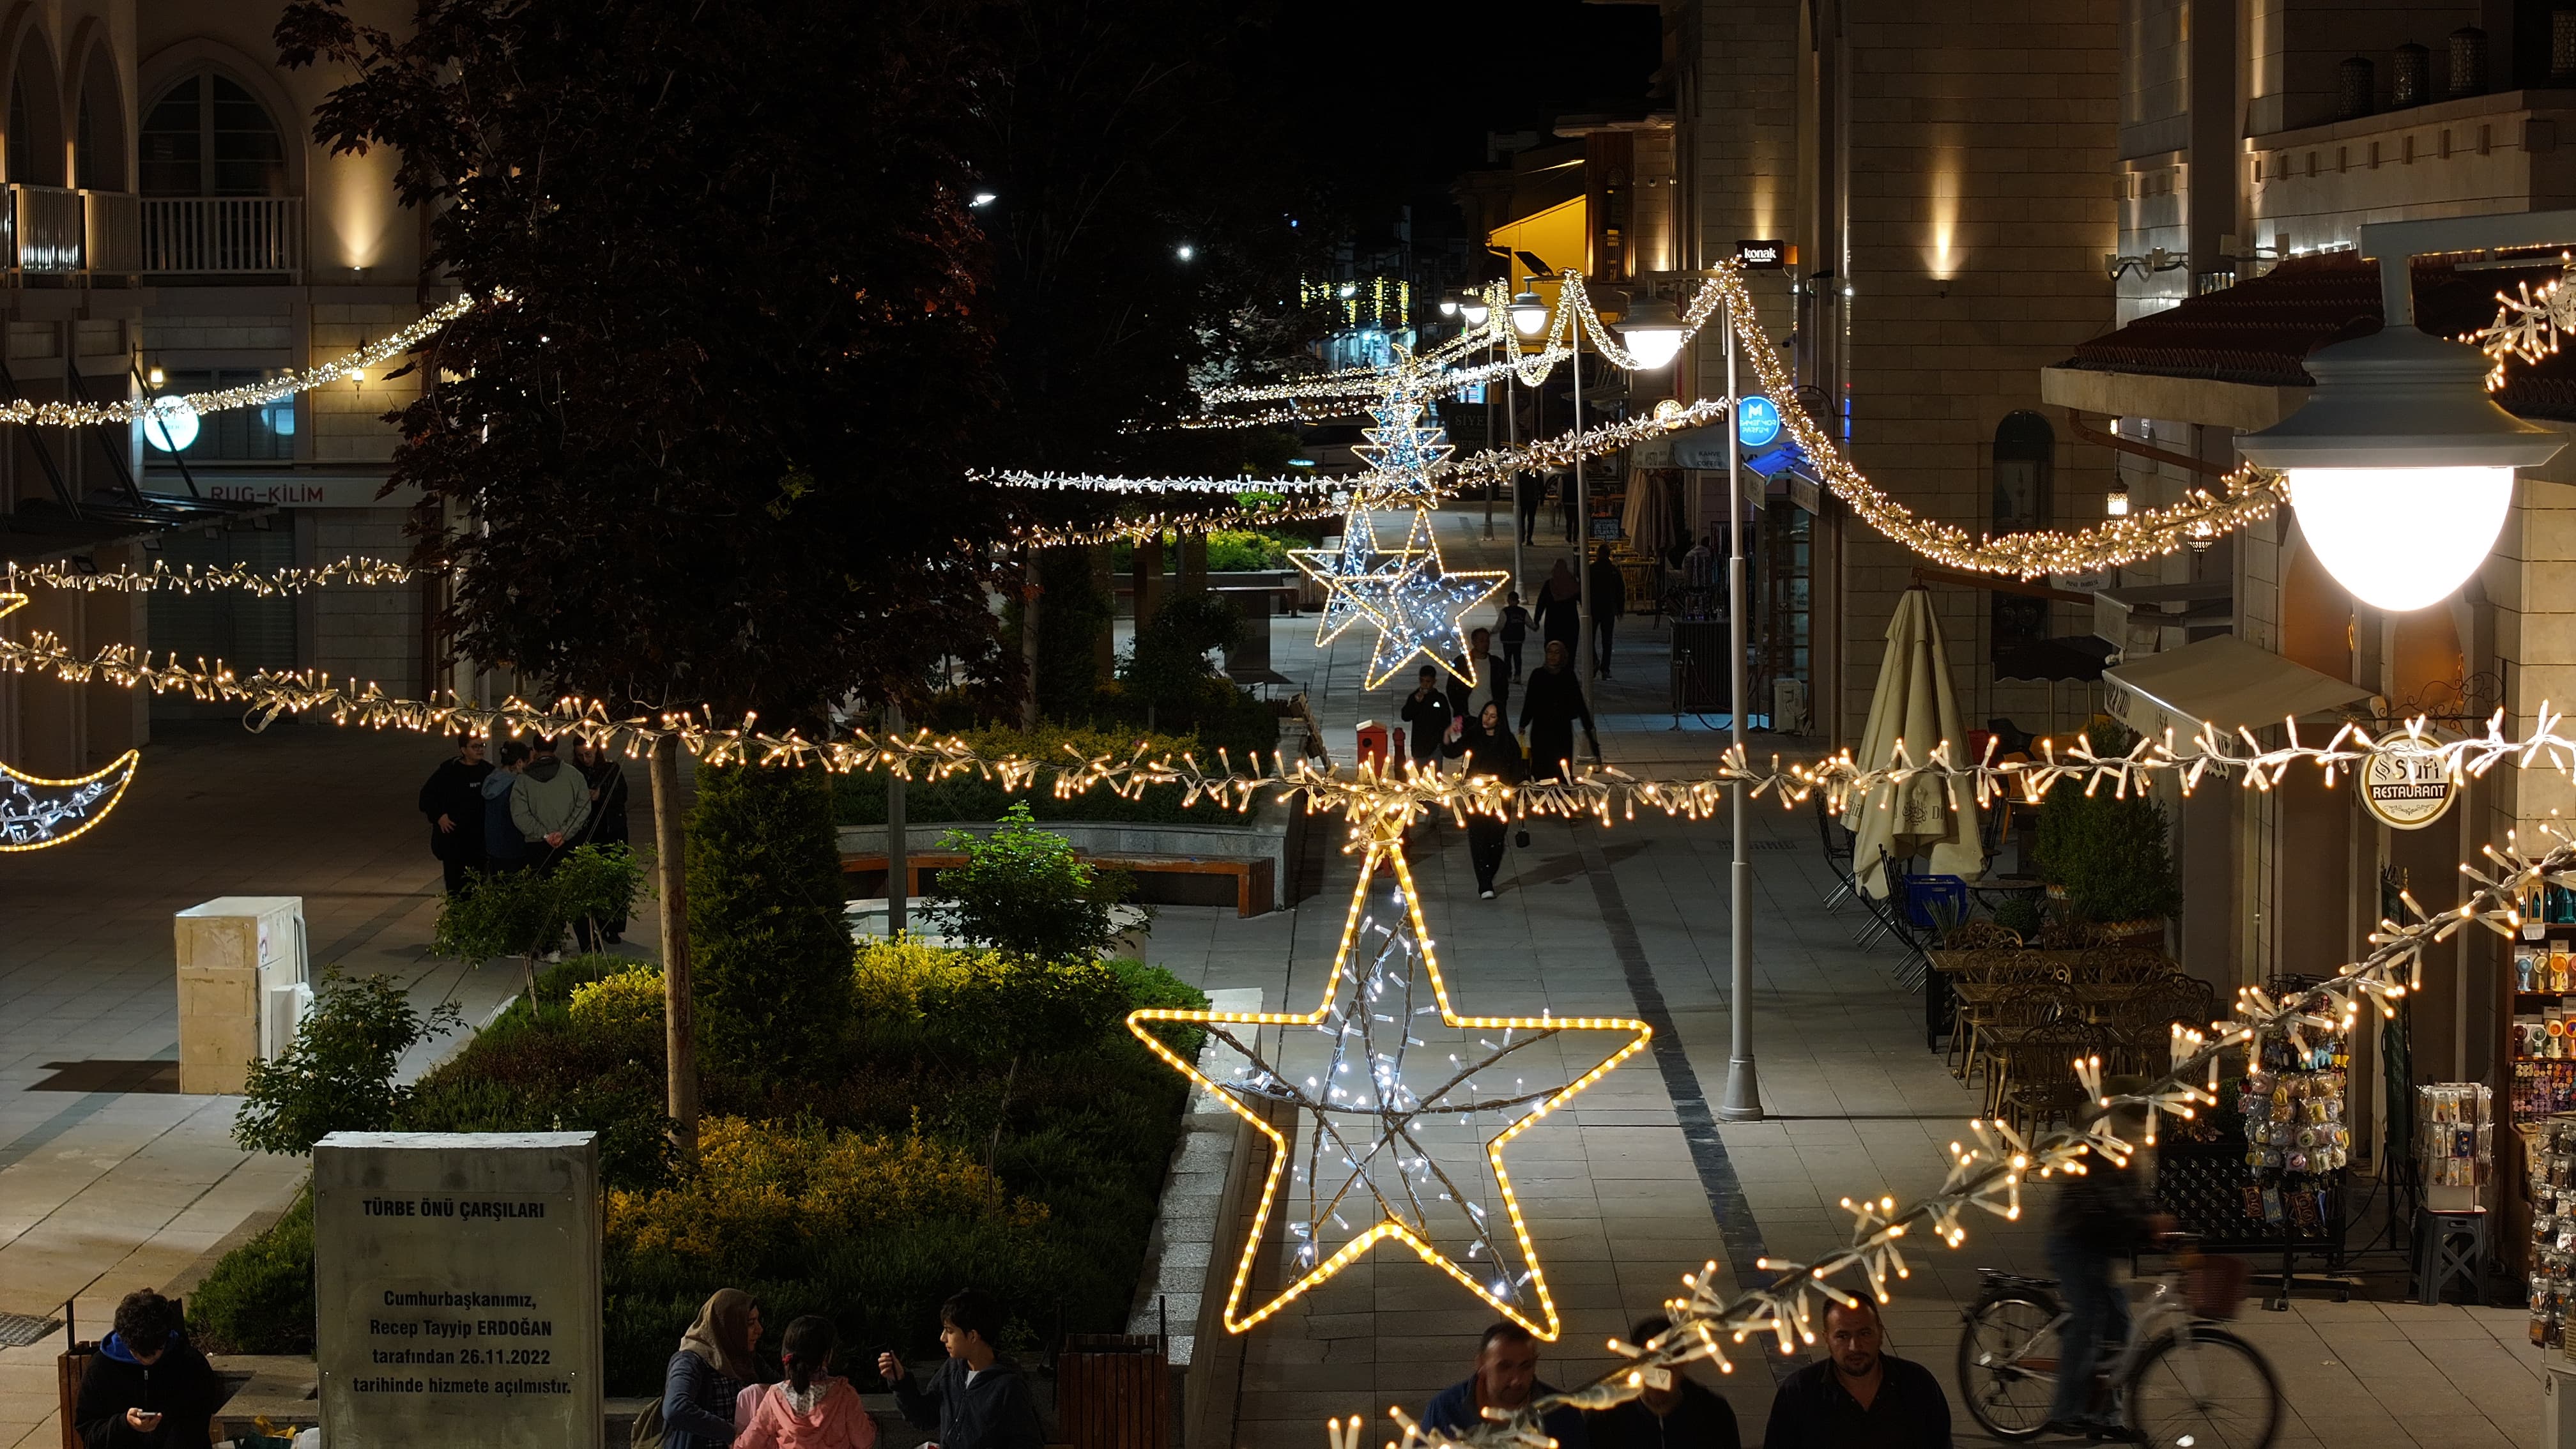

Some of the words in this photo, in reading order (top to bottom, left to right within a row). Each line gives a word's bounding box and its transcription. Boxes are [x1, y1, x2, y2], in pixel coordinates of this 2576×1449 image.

[1744, 247, 1777, 259] konak
[211, 484, 323, 503] RUG-KİLİM
[2373, 785, 2446, 799] RESTAURANT
[363, 1197, 415, 1217] TÜRBE
[421, 1197, 454, 1218] ÖNÜ
[460, 1202, 544, 1222] ÇARŞILARI
[384, 1291, 537, 1310] Cumhurbaşkanımız,
[371, 1319, 418, 1338] Recep
[423, 1320, 471, 1338] Tayyip
[478, 1317, 551, 1336] ERDOĞAN
[372, 1349, 455, 1364] tarafından
[461, 1349, 551, 1365] 26.11.2022
[353, 1377, 424, 1393] tarihinde
[429, 1378, 489, 1393] hizmete
